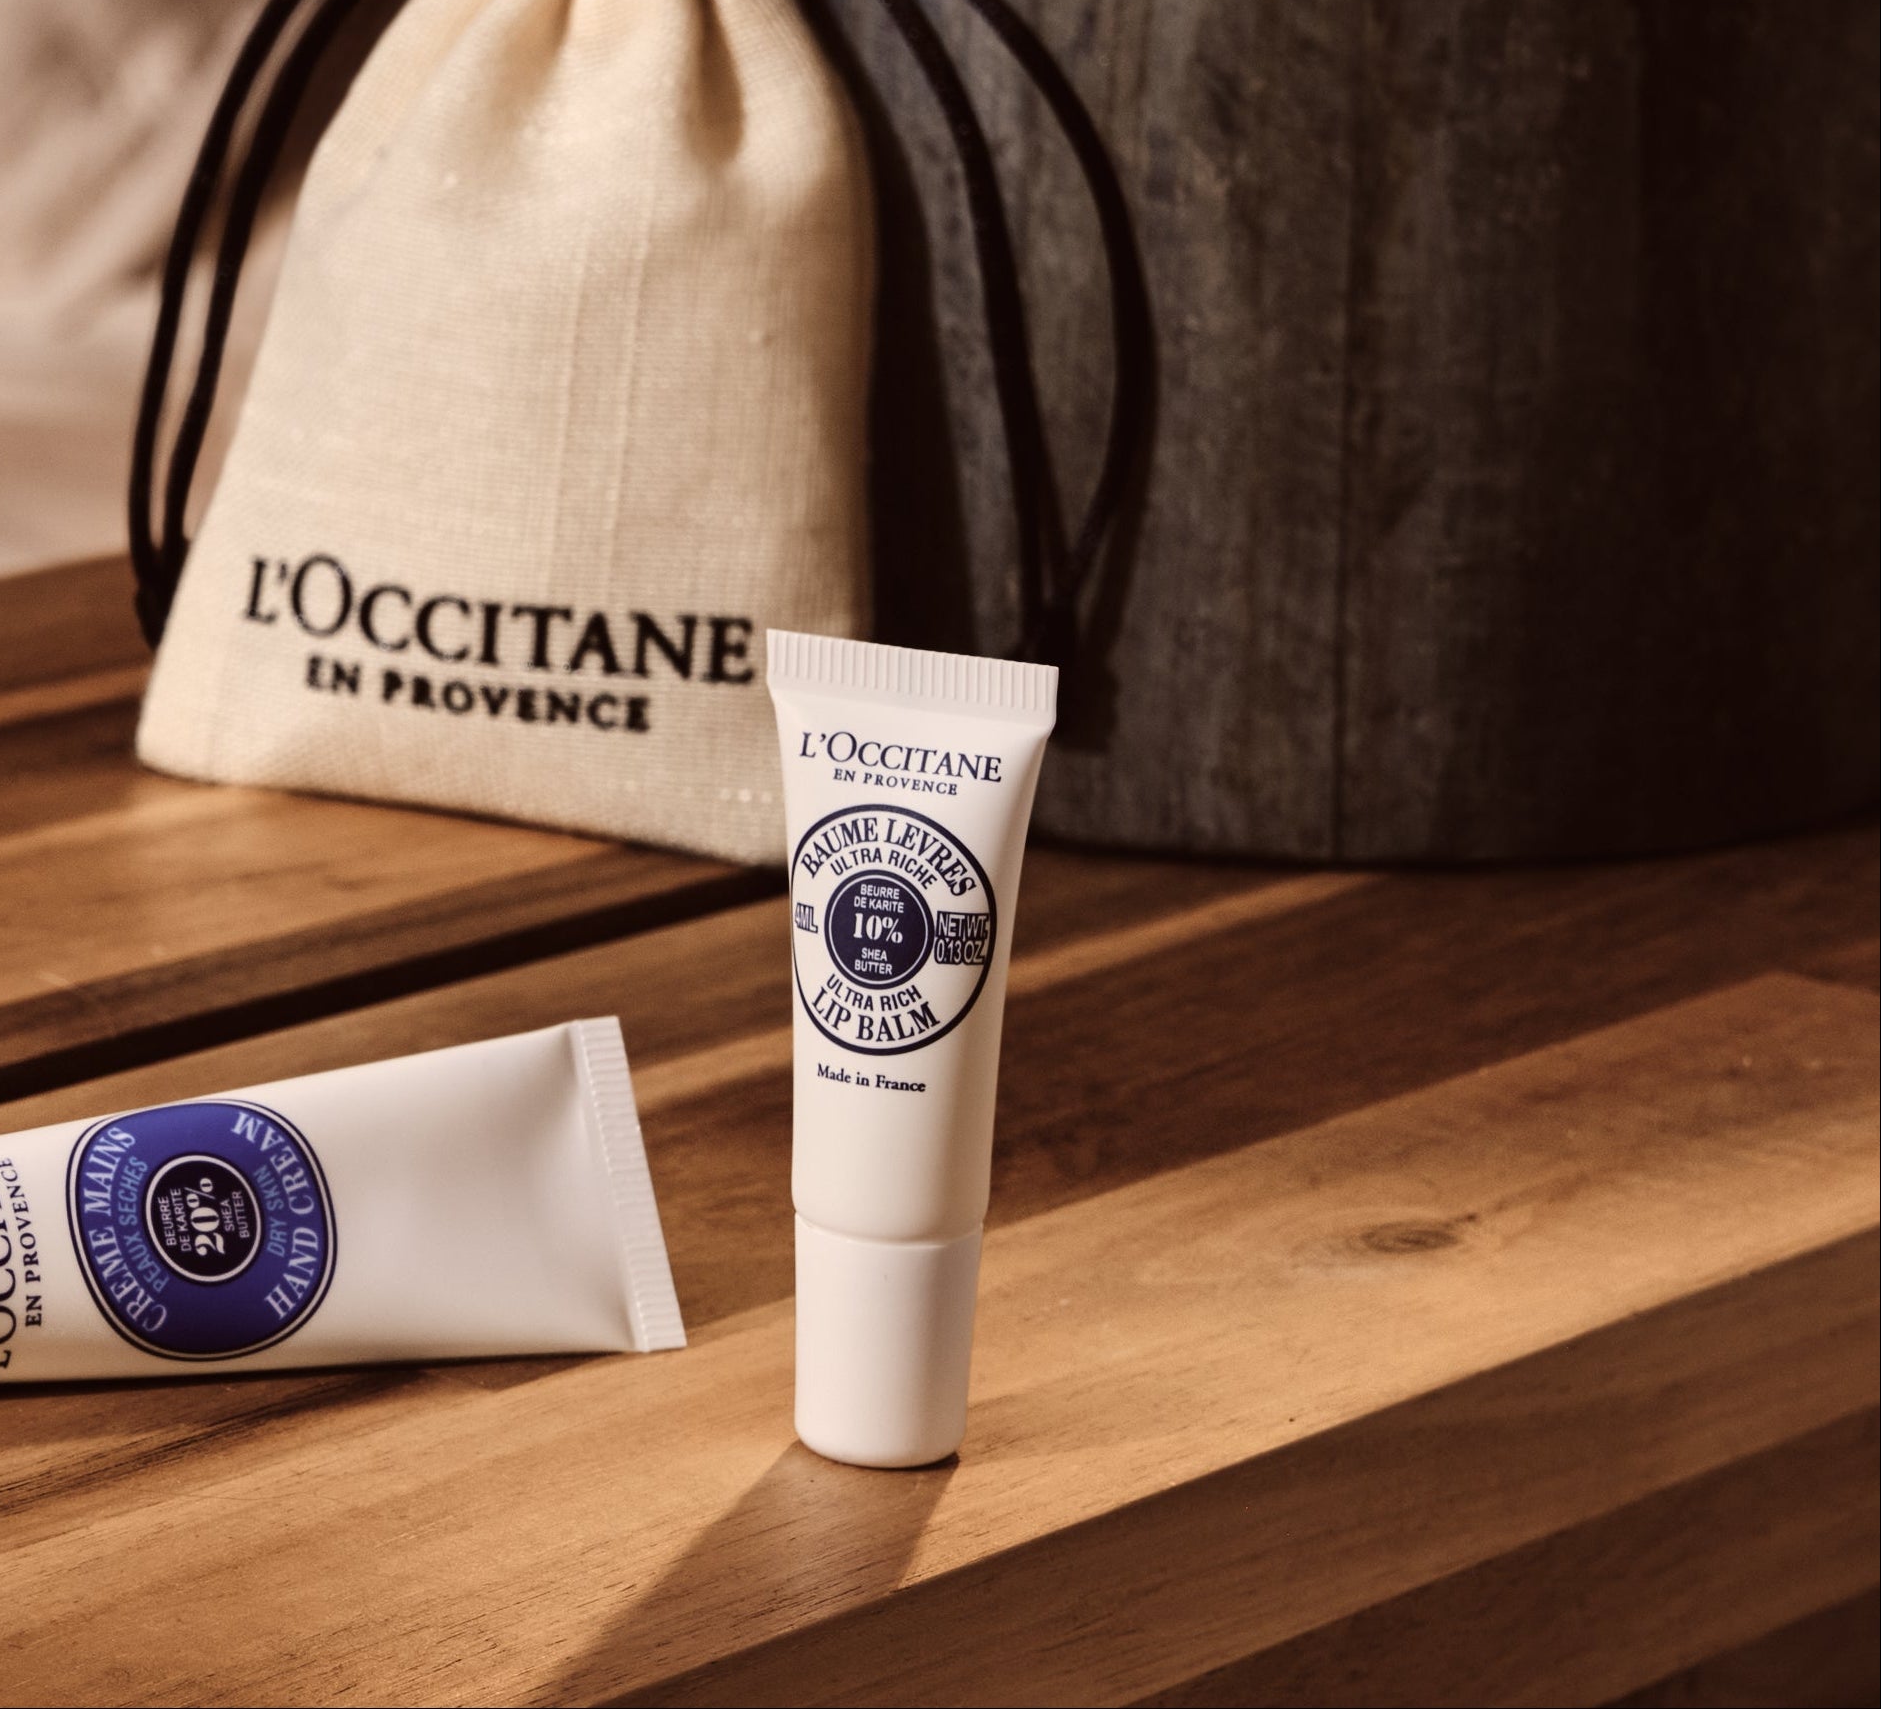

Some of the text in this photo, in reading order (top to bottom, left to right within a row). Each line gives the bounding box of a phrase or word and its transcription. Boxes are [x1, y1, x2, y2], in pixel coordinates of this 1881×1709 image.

[243, 553, 755, 686] L'OCCITANE
[307, 654, 651, 733] EN PROVENCE
[800, 731, 1002, 782] L'OCCITANE
[833, 768, 958, 795] EN PROVENCE
[801, 817, 977, 897] BAUME LEVRES
[830, 847, 938, 891] ULTRA RICHE
[854, 896, 905, 913] DE KARITE
[860, 883, 900, 900] BEURRE
[853, 912, 904, 944] 10%
[937, 912, 965, 937] NET
[854, 958, 893, 976] BUTTER
[861, 947, 888, 962] SHEA
[936, 939, 962, 963] 0.13
[812, 986, 940, 1042] LIP BALM
[826, 974, 922, 1011] ULTRA RICH
[817, 1063, 927, 1092] Made in France
[84, 1127, 167, 1332] CREME MAINS
[118, 1156, 170, 1293] PEAUX SECHES
[158, 1196, 177, 1246] BEURRE
[170, 1188, 191, 1251] DE KARITE
[184, 1177, 225, 1256] 20%
[221, 1199, 235, 1232] SHEA
[231, 1111, 319, 1320] HAND CREAM
[232, 1191, 250, 1238] BUTTER
[254, 1165, 287, 1258] DRY SKIN
[25, 1294, 42, 1328] EN
